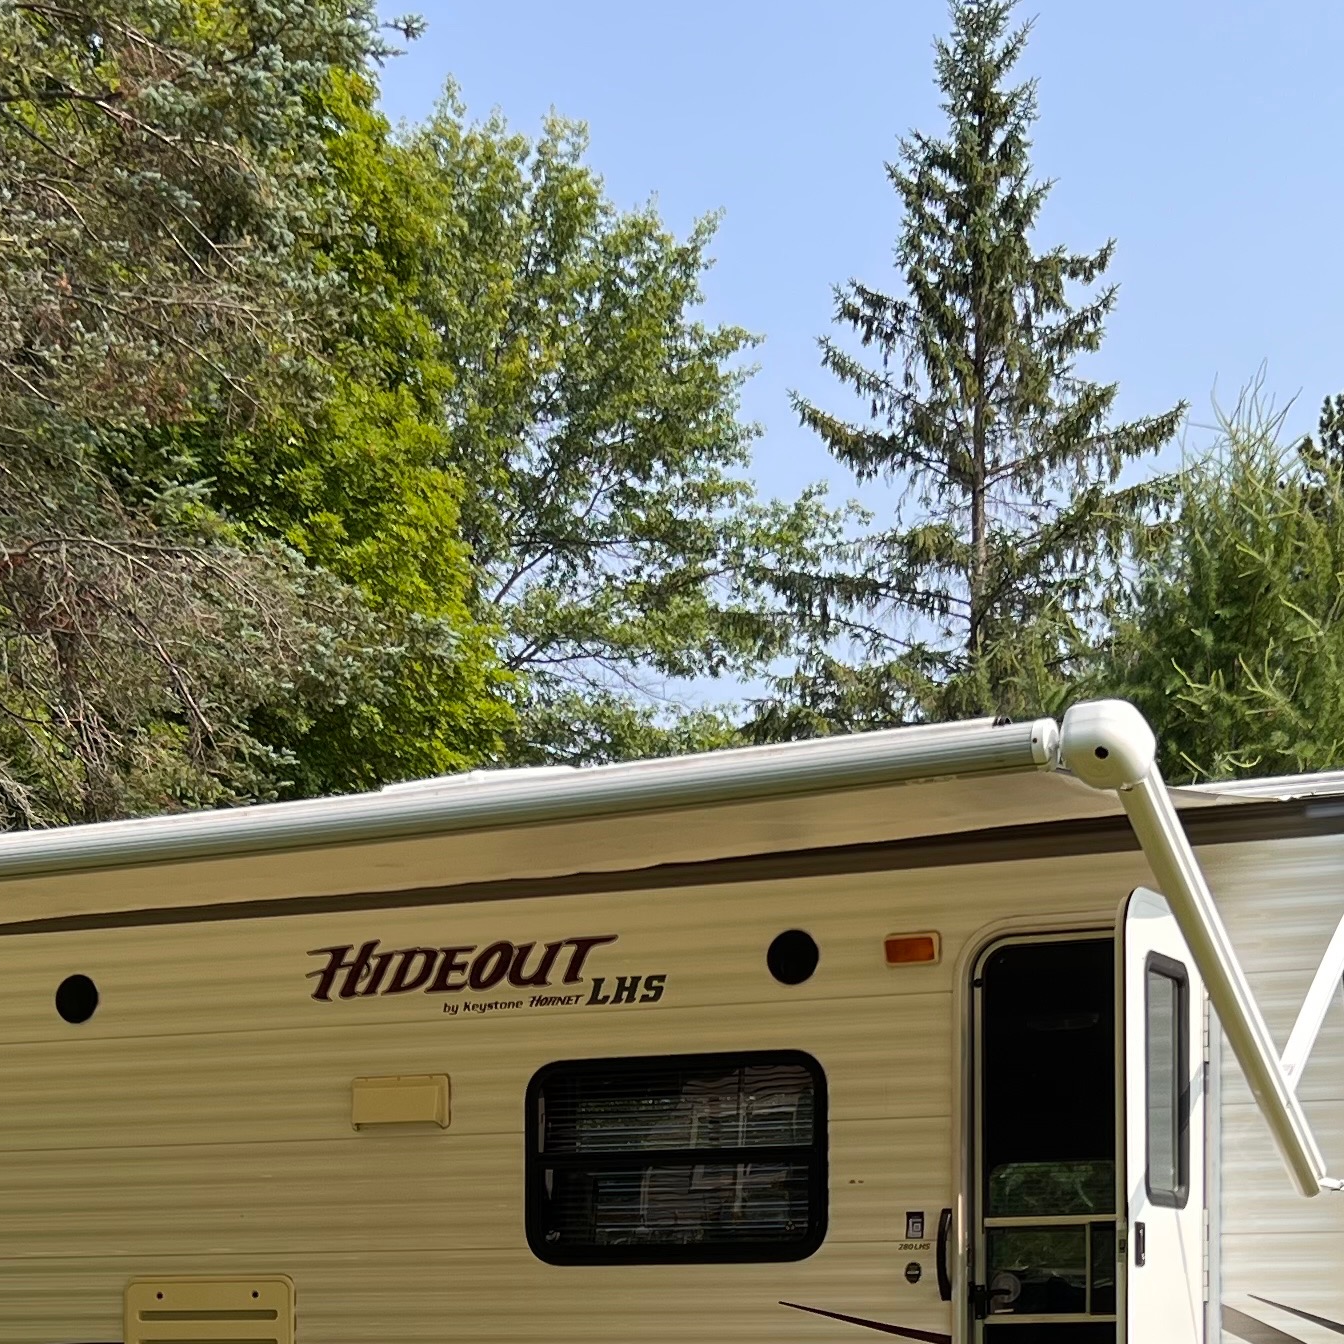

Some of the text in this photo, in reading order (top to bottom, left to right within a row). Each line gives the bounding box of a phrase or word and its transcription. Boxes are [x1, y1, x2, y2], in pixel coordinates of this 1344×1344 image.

[305, 933, 619, 1002] HIDEOUT
[442, 994, 585, 1015] by Keystone HORNET
[585, 974, 668, 1006] LHS
